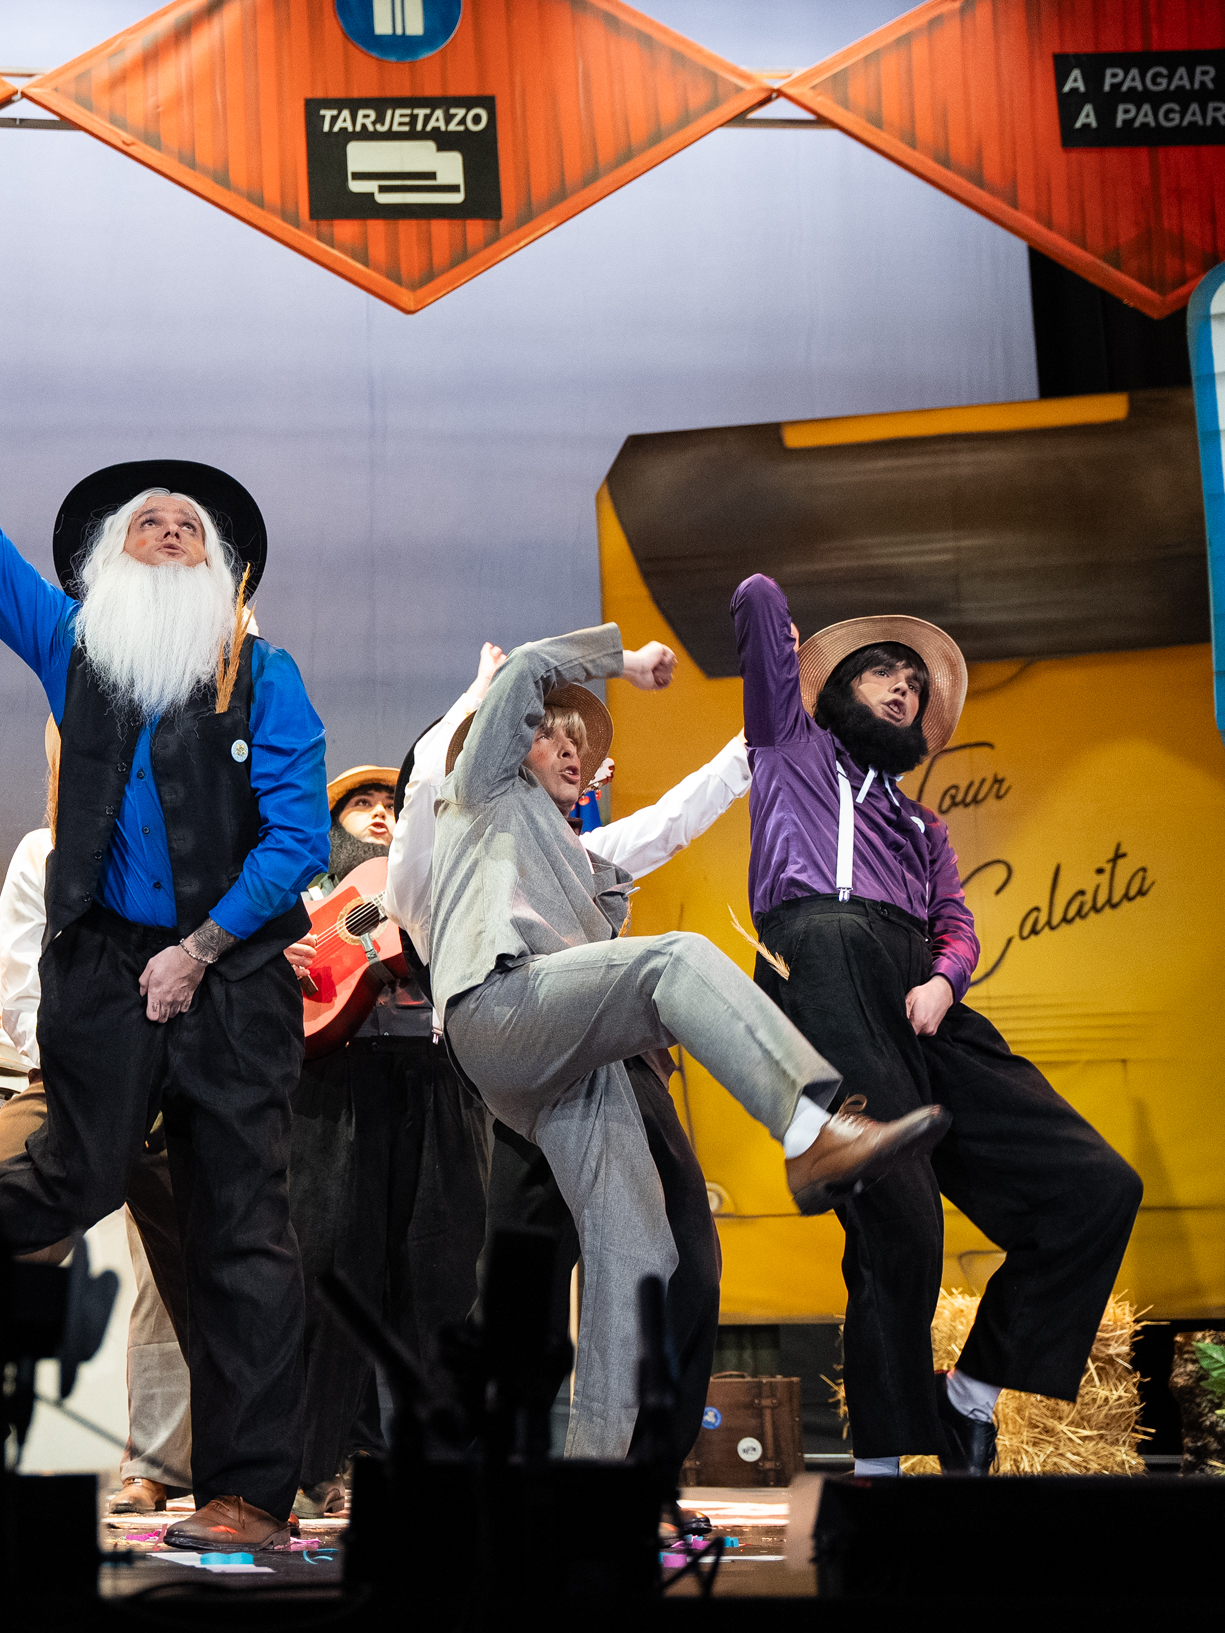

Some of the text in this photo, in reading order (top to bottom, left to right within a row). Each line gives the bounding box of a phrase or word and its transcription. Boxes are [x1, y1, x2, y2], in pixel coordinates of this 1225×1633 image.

[1061, 65, 1216, 93] A PAGAR
[319, 107, 488, 133] TARJETAZO
[1074, 101, 1225, 129] A PAGAR
[917, 741, 1011, 814] Tour
[962, 842, 1155, 988] Calaita
